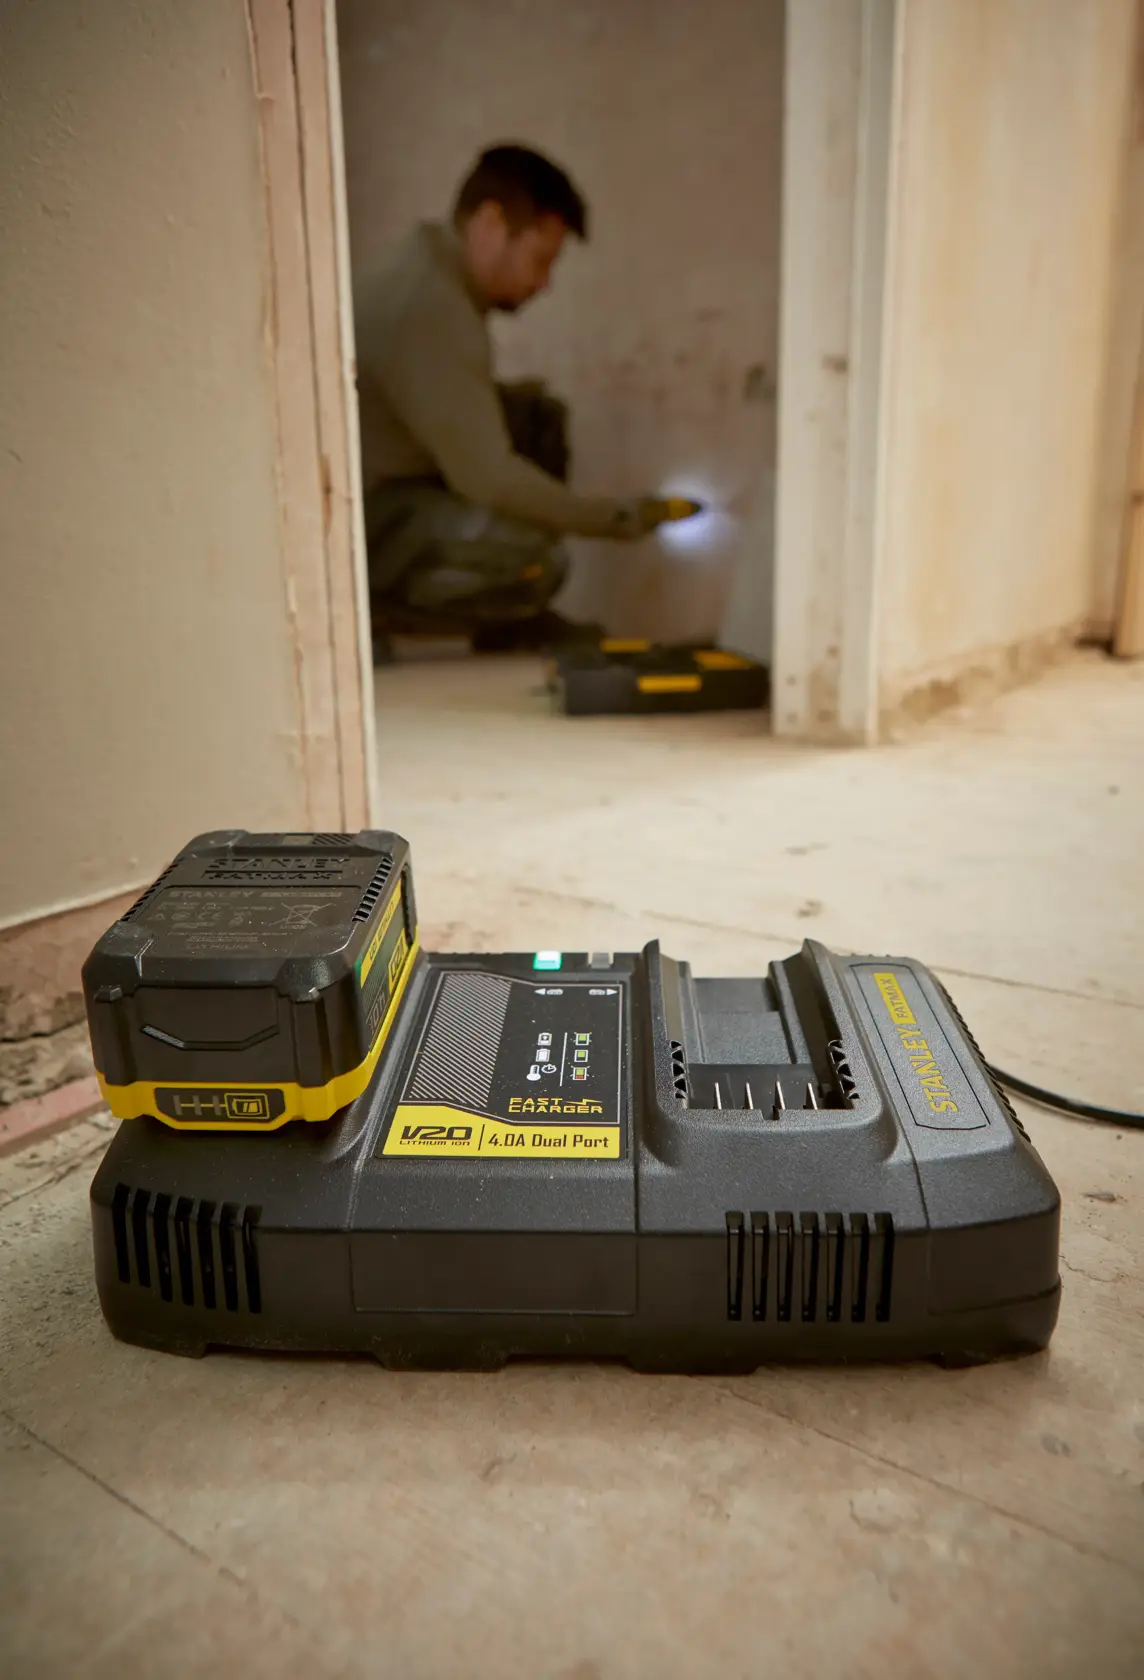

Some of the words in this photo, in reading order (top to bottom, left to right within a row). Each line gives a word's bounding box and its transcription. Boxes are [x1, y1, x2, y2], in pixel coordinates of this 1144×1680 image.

[208, 858, 350, 869] STANLEY
[879, 978, 909, 1019] FATMAX
[896, 1026, 959, 1113] STANLEY
[508, 1104, 603, 1114] CHARGER
[509, 1097, 563, 1106] FAST
[400, 1125, 473, 1141] V20
[488, 1133, 526, 1147] 4.0A
[531, 1133, 568, 1148] Dual
[572, 1134, 609, 1148] Port
